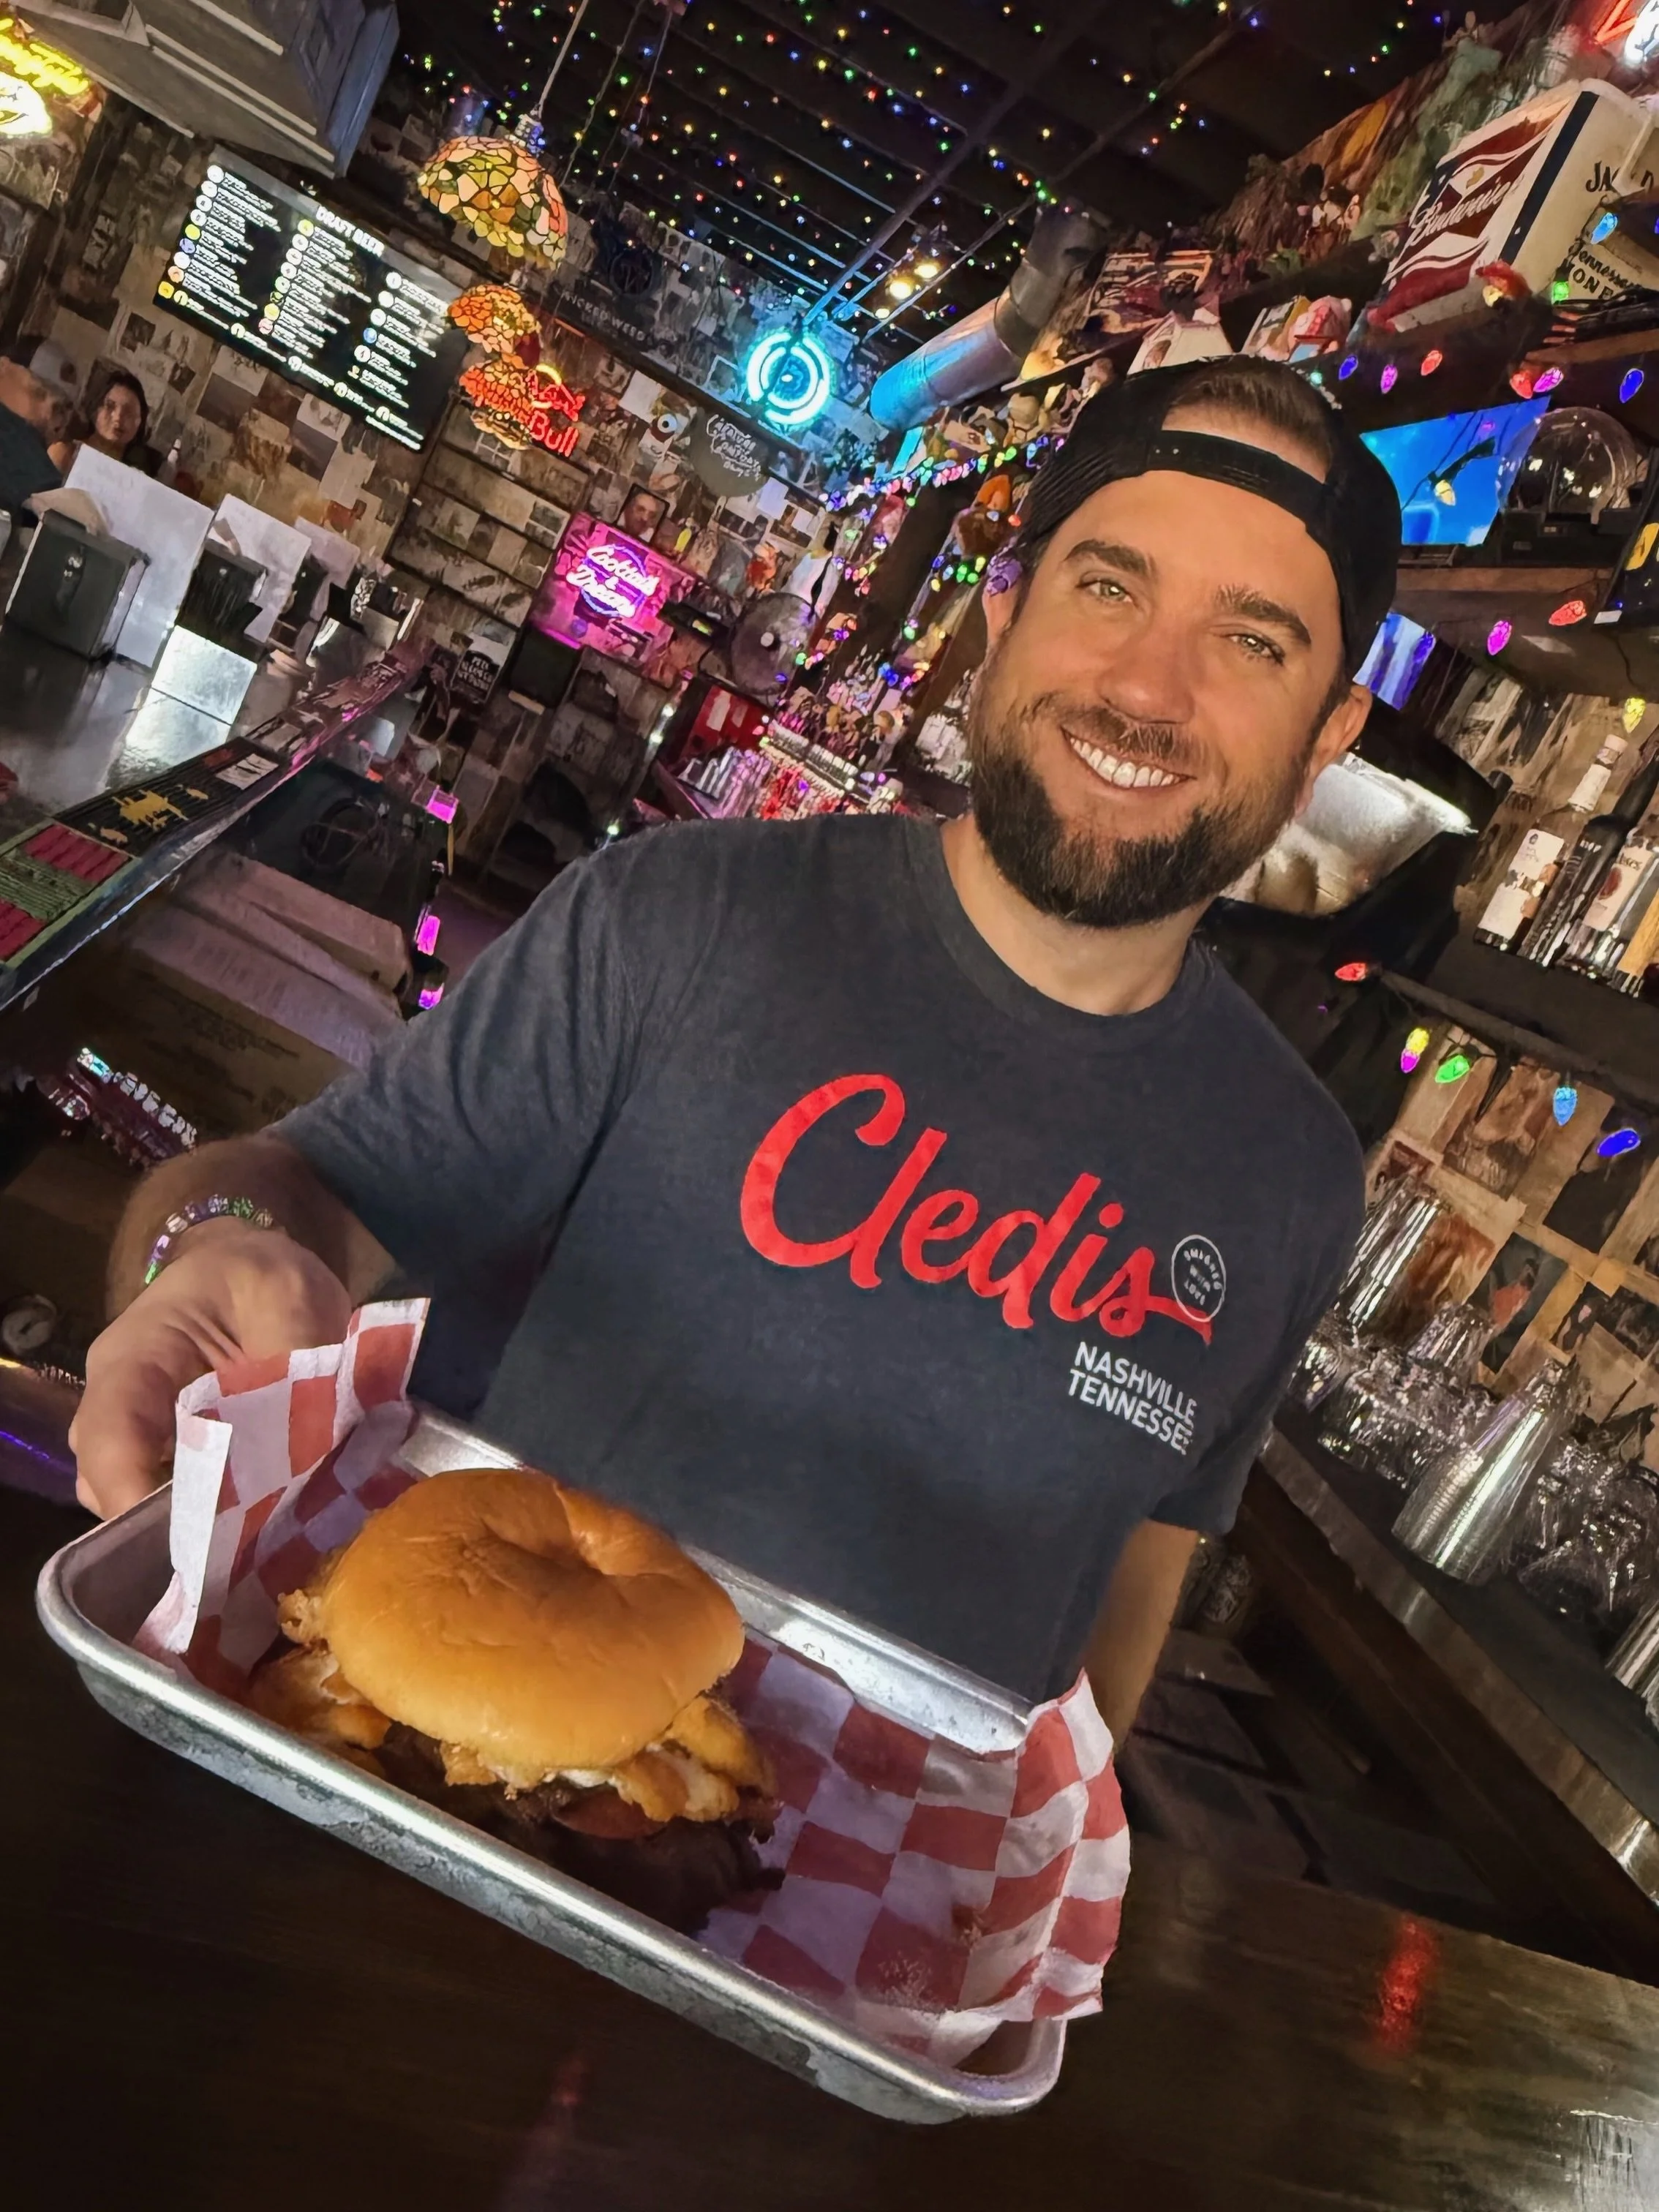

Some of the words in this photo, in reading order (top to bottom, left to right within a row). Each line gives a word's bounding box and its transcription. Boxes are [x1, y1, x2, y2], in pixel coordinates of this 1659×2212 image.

[316, 205, 356, 238] DRAFT
[352, 228, 385, 257] BEER
[612, 317, 646, 342] WEED
[529, 410, 579, 457] Bull
[740, 1073, 1212, 1345] Cledis
[1075, 1341, 1197, 1428] NASHVILLE
